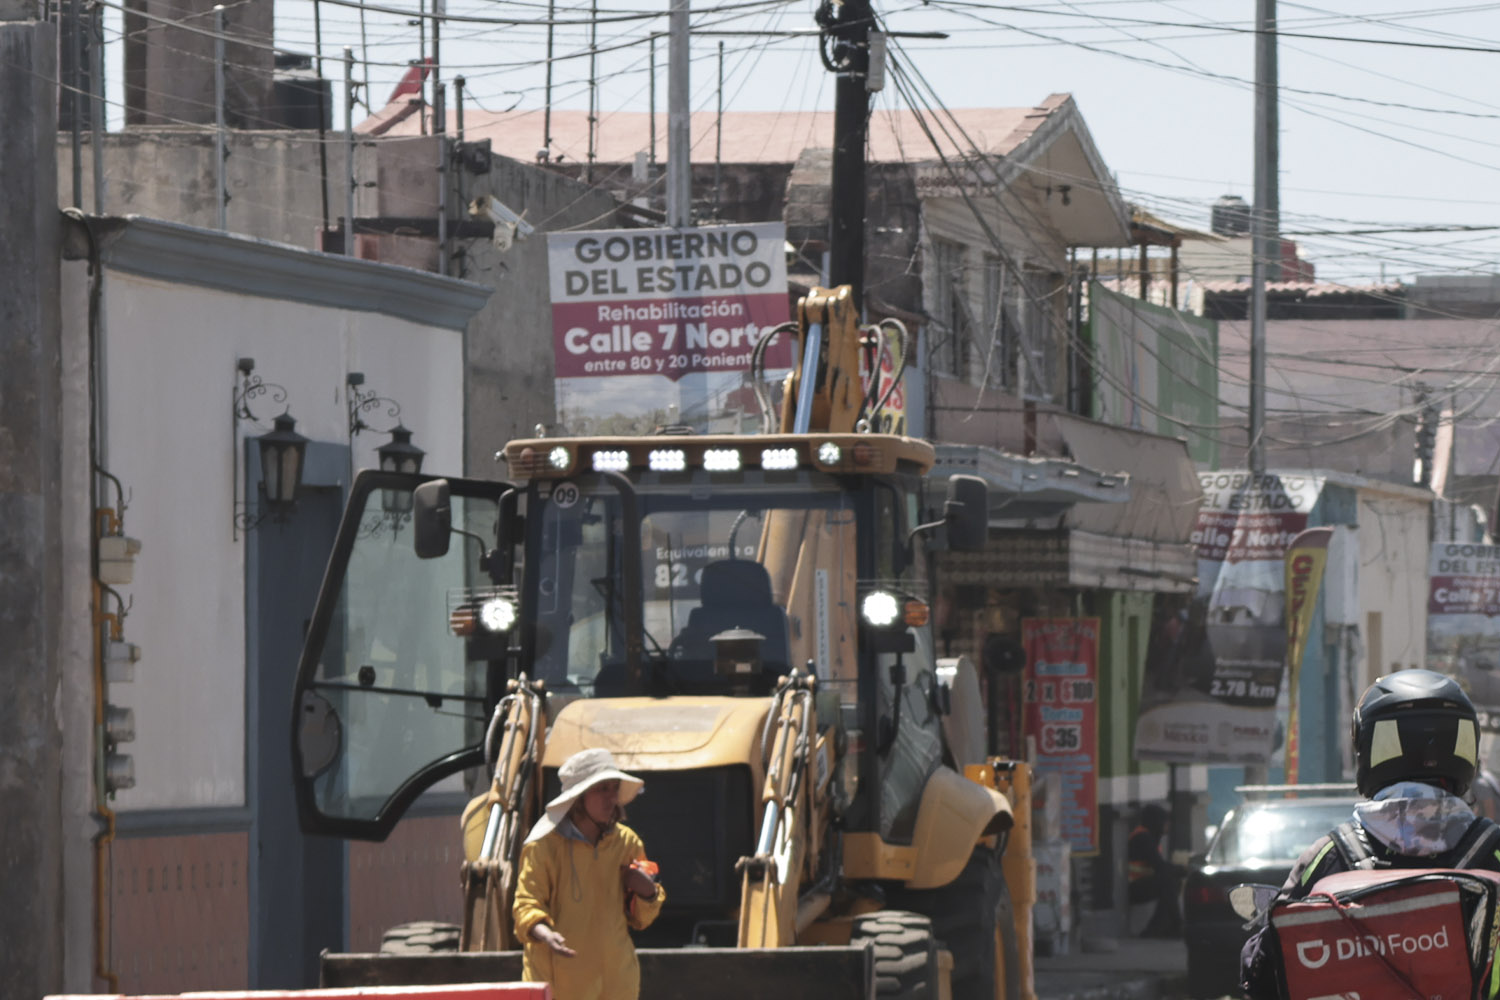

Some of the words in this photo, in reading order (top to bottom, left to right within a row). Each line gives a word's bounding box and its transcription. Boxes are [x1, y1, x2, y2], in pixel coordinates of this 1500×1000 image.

[574, 230, 758, 264] GOBIERNO
[565, 269, 628, 297] DEL
[637, 261, 772, 295] ESTADO
[598, 301, 743, 323] Rehabilitación
[564, 324, 652, 355] Calle
[657, 324, 678, 350] 7
[584, 358, 627, 373] entre
[630, 356, 652, 370] 80
[655, 358, 665, 372] y
[668, 355, 688, 368] 20
[691, 352, 756, 368] Ponient
[1200, 474, 1304, 491] GOBIERNO
[555, 487, 577, 503] 09
[1202, 492, 1221, 508] EL
[1229, 494, 1303, 509] ESTADO
[1190, 528, 1229, 546] alle
[1232, 529, 1244, 546] 7
[743, 546, 755, 556] a
[655, 564, 688, 587] 82
[1439, 560, 1470, 572] DEL
[1434, 588, 1480, 603] Calle
[1483, 589, 1495, 602] 7
[1026, 680, 1037, 702] 2
[1210, 681, 1246, 697] 2.78
[1249, 682, 1276, 698] km
[1044, 726, 1080, 748] $35
[1336, 934, 1385, 960] DiDi
[1387, 926, 1449, 956] Food
